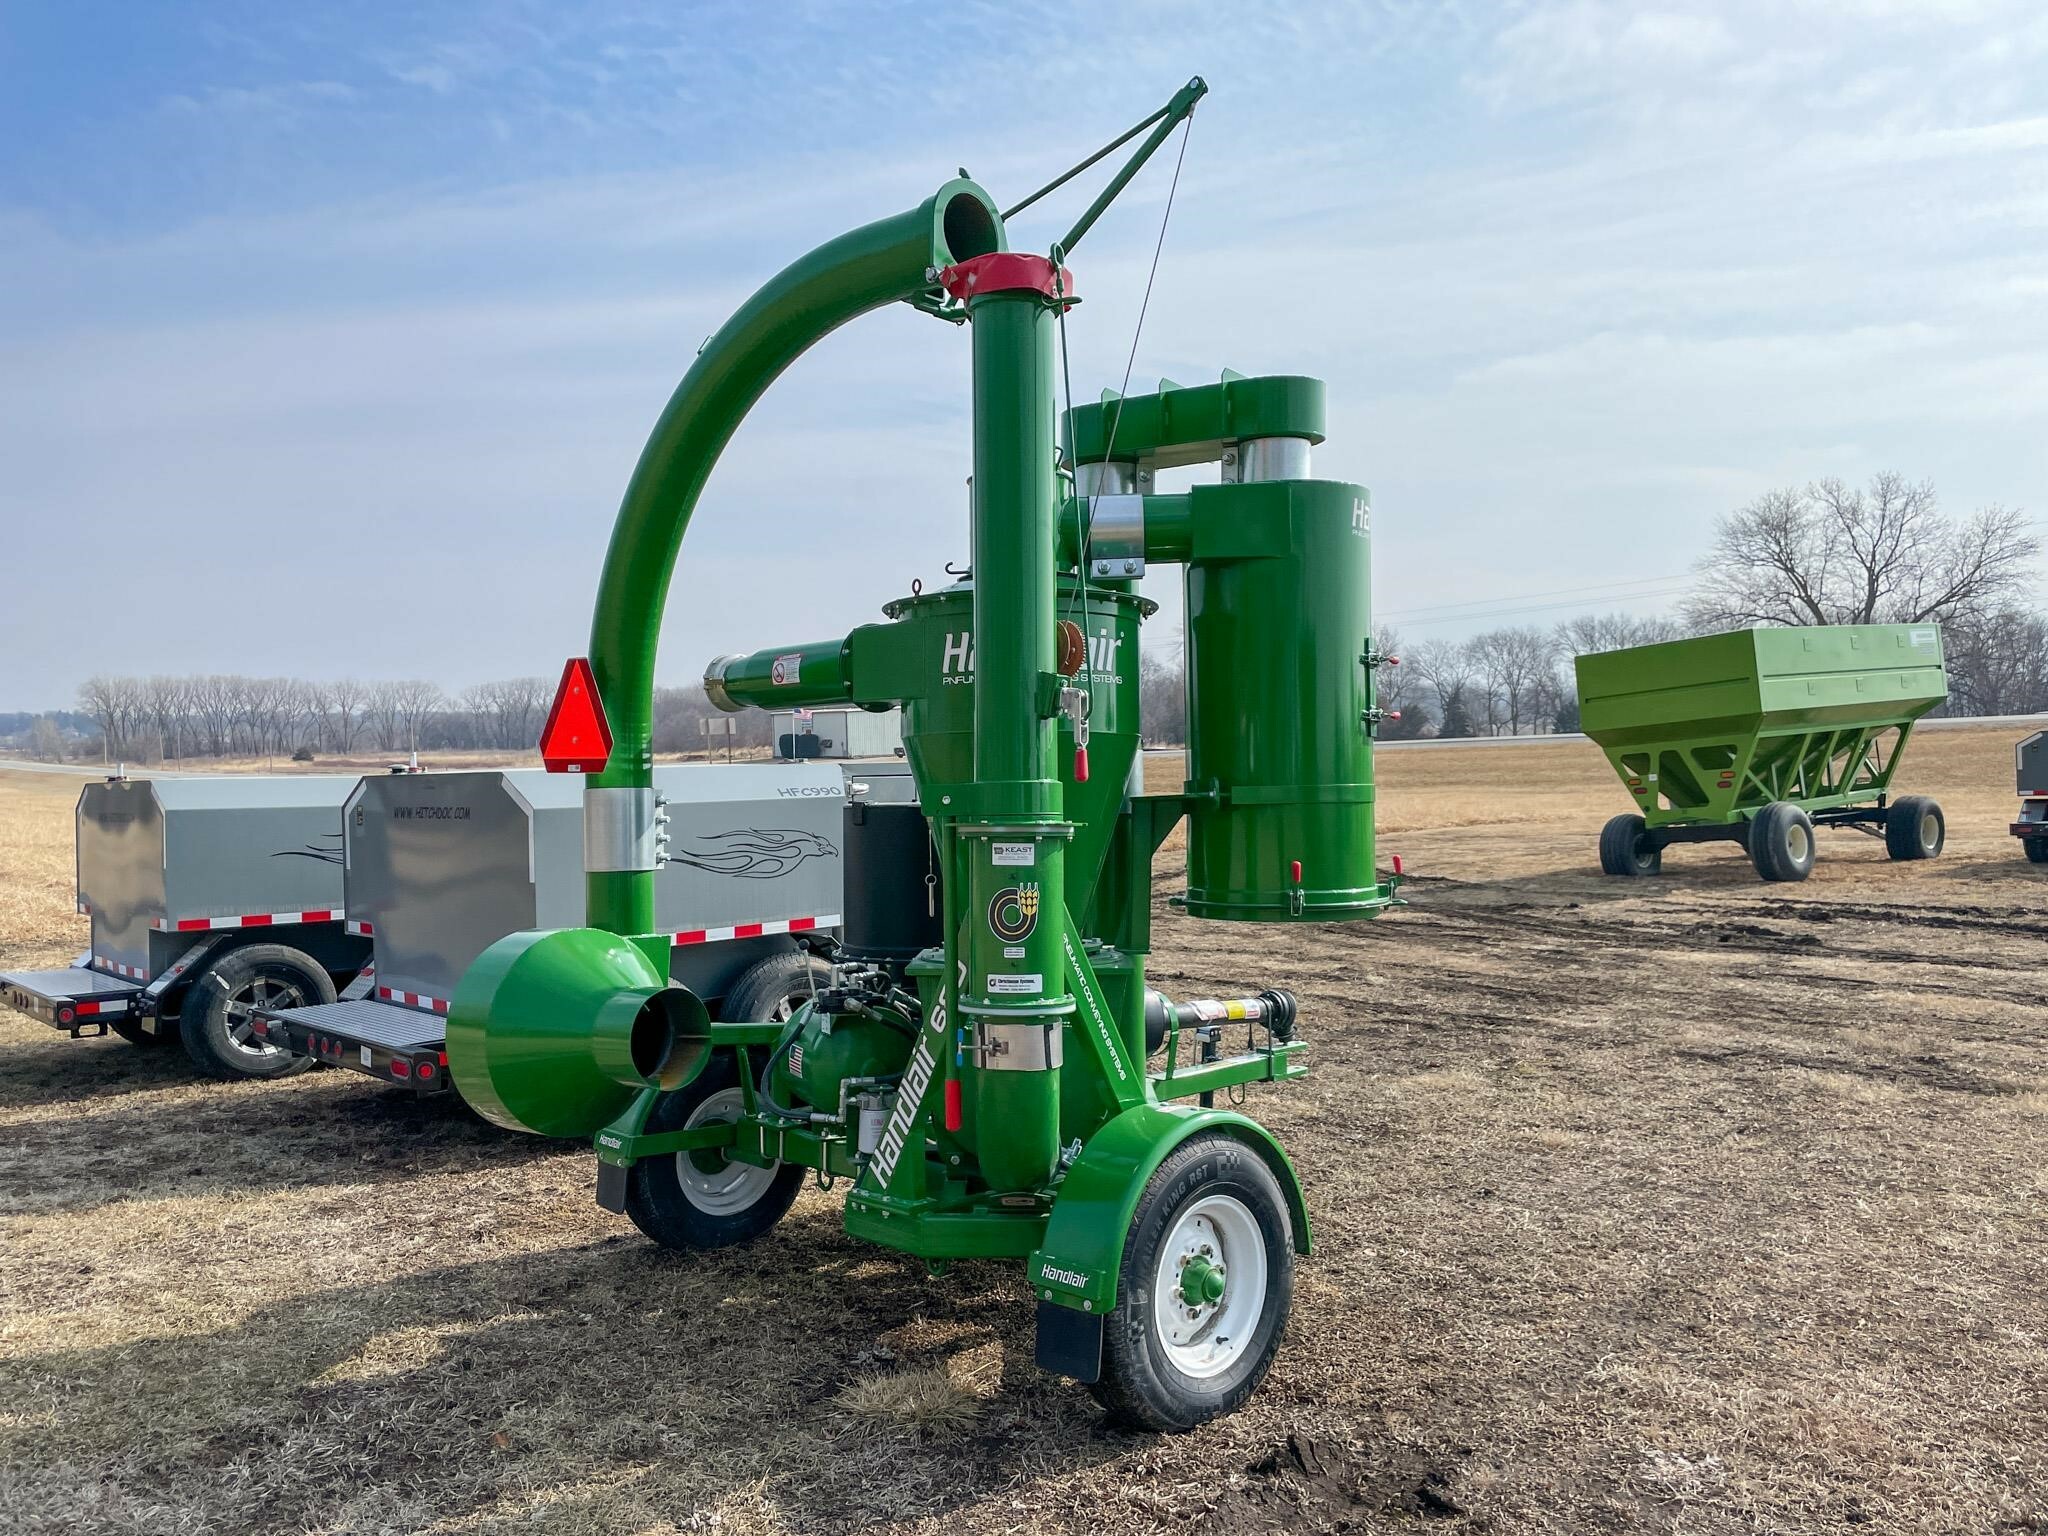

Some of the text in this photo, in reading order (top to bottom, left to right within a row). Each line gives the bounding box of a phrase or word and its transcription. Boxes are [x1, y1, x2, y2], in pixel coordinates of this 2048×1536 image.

[777, 786, 841, 797] HFC990
[1083, 985, 1109, 1039] CONVEYING
[1105, 1037, 1127, 1081] SYSTEMS
[868, 1034, 936, 1190] Handlair
[1162, 1181, 1186, 1216] KING
[1188, 1164, 1209, 1185] RST
[1041, 1263, 1089, 1289] Handlair
